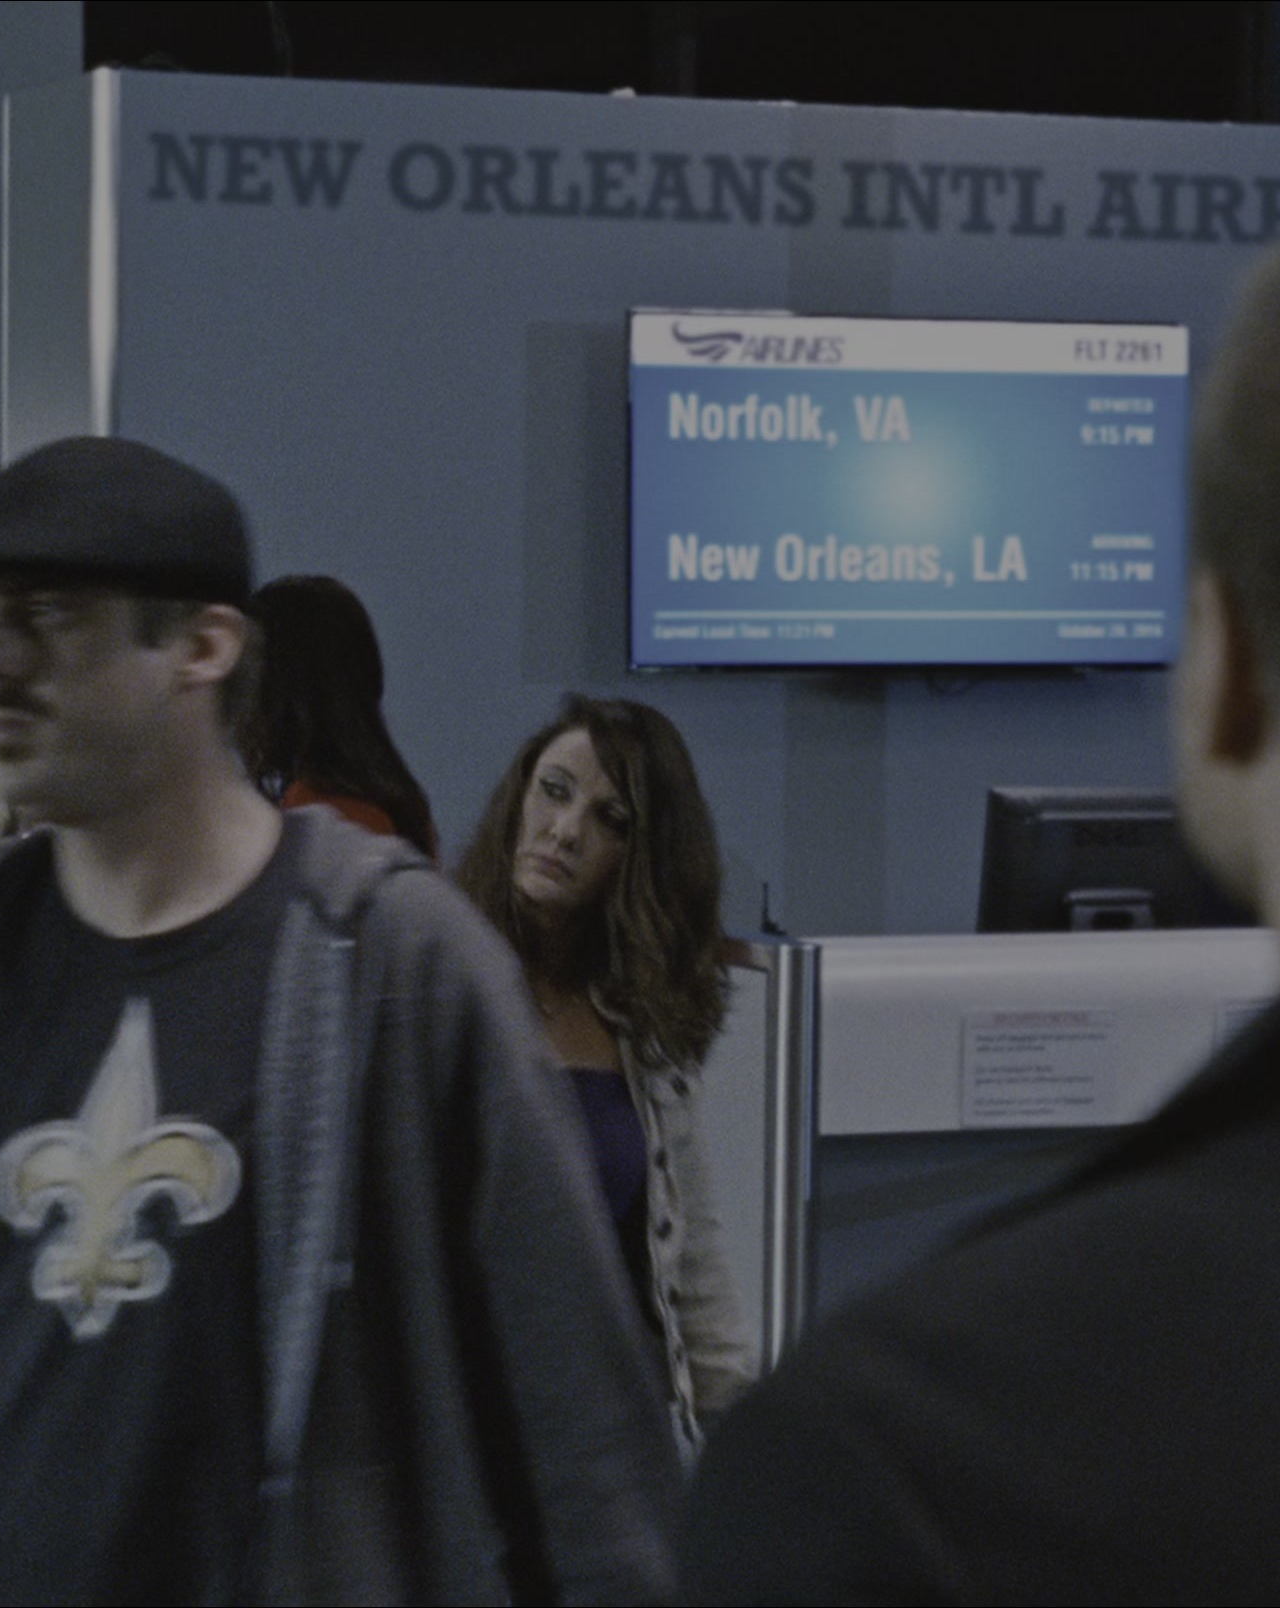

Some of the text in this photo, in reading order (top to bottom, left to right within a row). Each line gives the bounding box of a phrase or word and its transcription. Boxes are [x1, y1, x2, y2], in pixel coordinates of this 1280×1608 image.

[148, 133, 363, 209] NEW
[386, 141, 816, 229] ORLEANS
[841, 160, 1066, 238] INTL
[739, 335, 845, 364] AIRLINES
[1074, 339, 1163, 362] FLT 2261
[669, 392, 911, 447] Norfolk, VA
[1080, 424, 1154, 445] 9:15 PM
[669, 533, 1028, 587] New Orleans, LA
[1070, 561, 1154, 581] 11:15 PM
